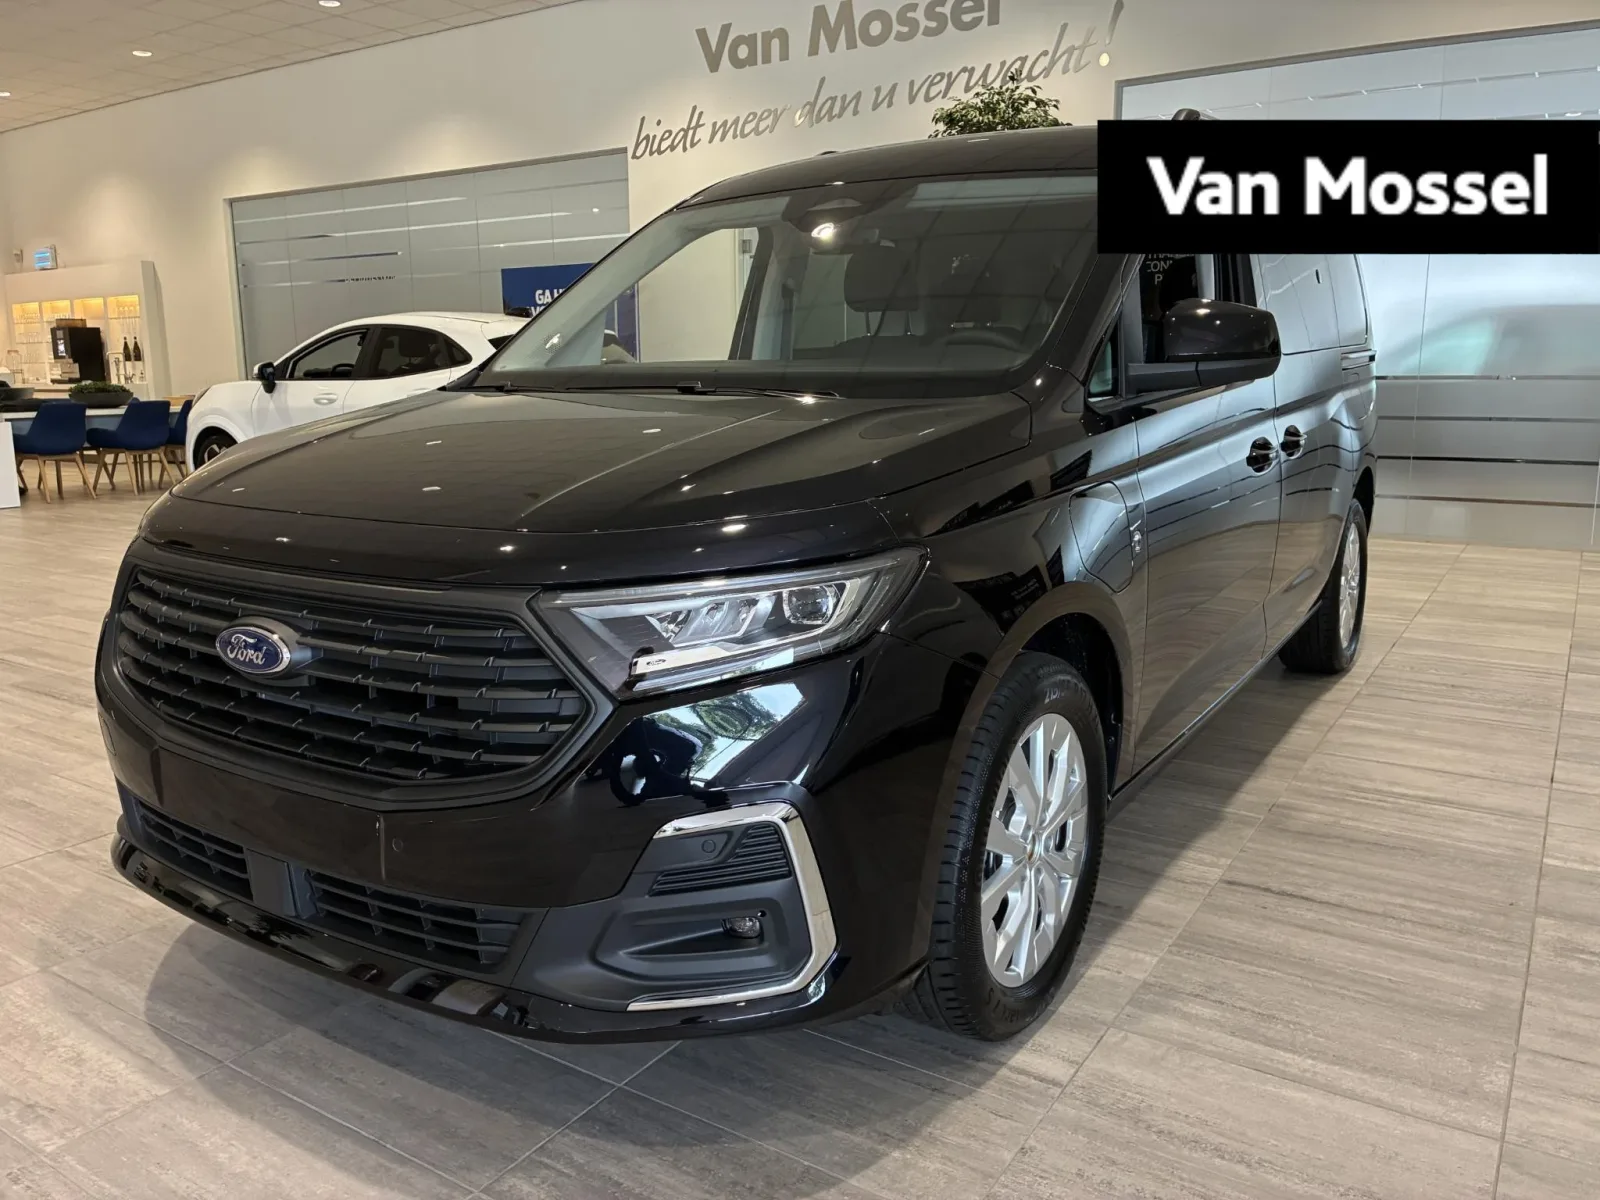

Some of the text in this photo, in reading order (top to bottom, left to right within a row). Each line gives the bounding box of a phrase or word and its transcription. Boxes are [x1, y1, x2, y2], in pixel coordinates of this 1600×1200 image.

[695, 22, 790, 74] Van
[631, 104, 705, 160] biedt
[708, 103, 791, 145] meer
[794, 75, 862, 129] dan
[872, 82, 899, 112] u
[227, 633, 267, 665] Ford
